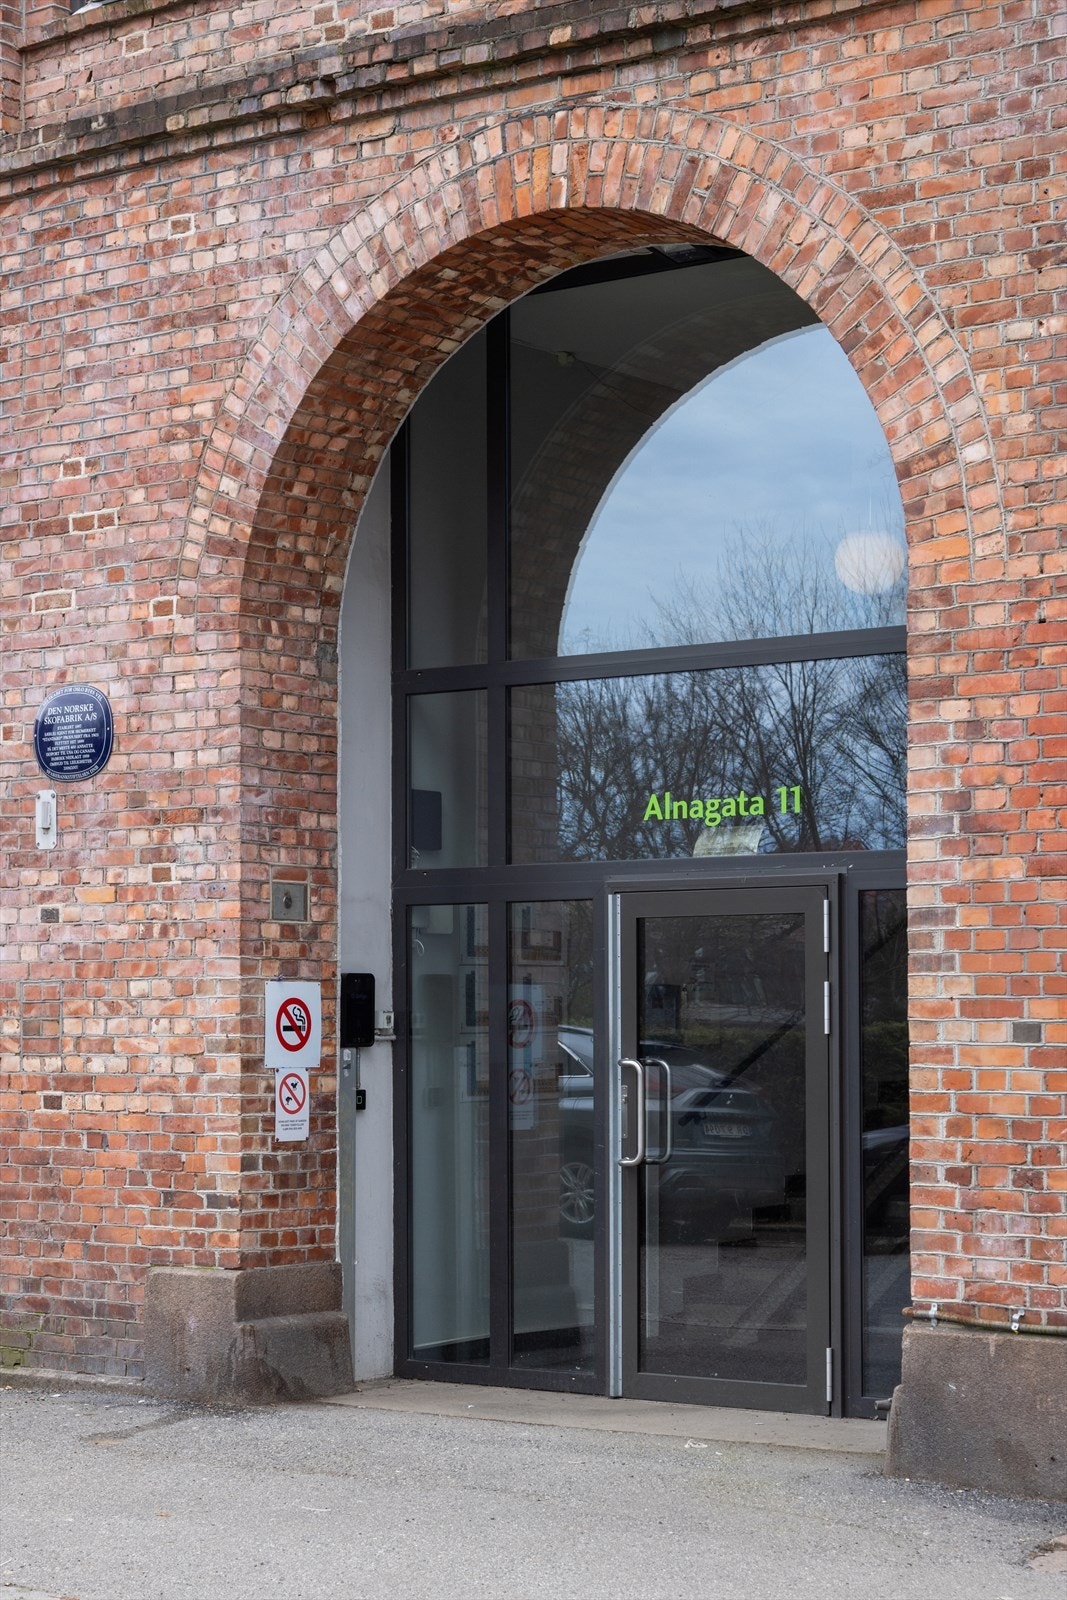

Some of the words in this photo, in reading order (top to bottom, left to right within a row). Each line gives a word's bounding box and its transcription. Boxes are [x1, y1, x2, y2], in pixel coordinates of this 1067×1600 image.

[48, 706, 62, 715] DEN
[64, 703, 94, 714] NORSKE
[44, 714, 83, 725] SKOFABRIK
[84, 712, 97, 721] A/S
[643, 792, 764, 827] Alnagata
[776, 784, 800, 814] 11
